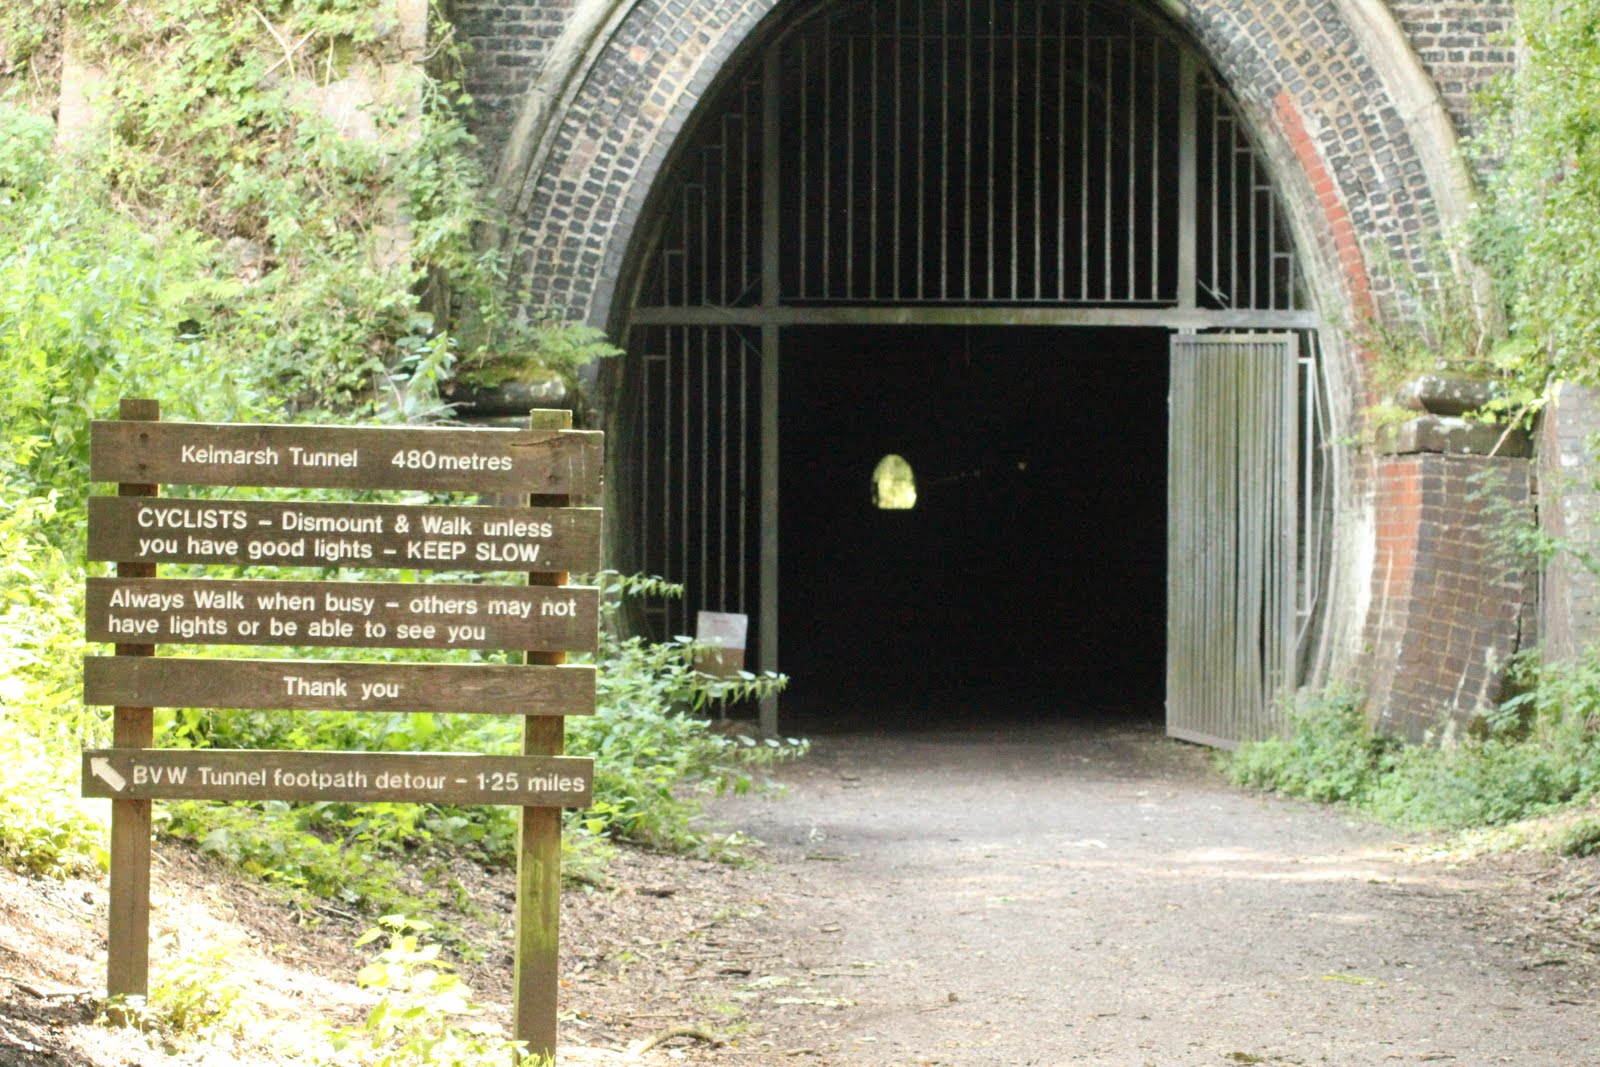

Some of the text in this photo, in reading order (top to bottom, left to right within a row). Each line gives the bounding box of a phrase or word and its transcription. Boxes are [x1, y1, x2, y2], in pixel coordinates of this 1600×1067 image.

[181, 444, 279, 466] Kelmarsh
[288, 446, 358, 468] Tunnel
[137, 507, 248, 530] CYCLISTS
[282, 510, 384, 534] Dismount
[394, 514, 410, 534] &
[421, 515, 473, 536] Walk
[483, 518, 553, 538] unless
[139, 538, 178, 557] you
[187, 535, 239, 556] have
[247, 537, 307, 560] good
[314, 538, 373, 562] lights
[407, 540, 467, 561] KEEP
[475, 542, 540, 563] SLOW
[109, 588, 185, 612] Always
[193, 590, 245, 610] Walk
[256, 591, 316, 612] when
[325, 592, 375, 616] busy
[409, 594, 479, 616] others
[487, 599, 532, 619] may
[541, 598, 577, 618] not
[108, 614, 486, 644] have lights or be able to see you
[282, 675, 400, 702] Thank you
[133, 765, 188, 785] BVW
[197, 766, 267, 786] Tunnel
[273, 768, 368, 791] footpath
[375, 771, 447, 790] detour
[527, 773, 586, 793] miles
